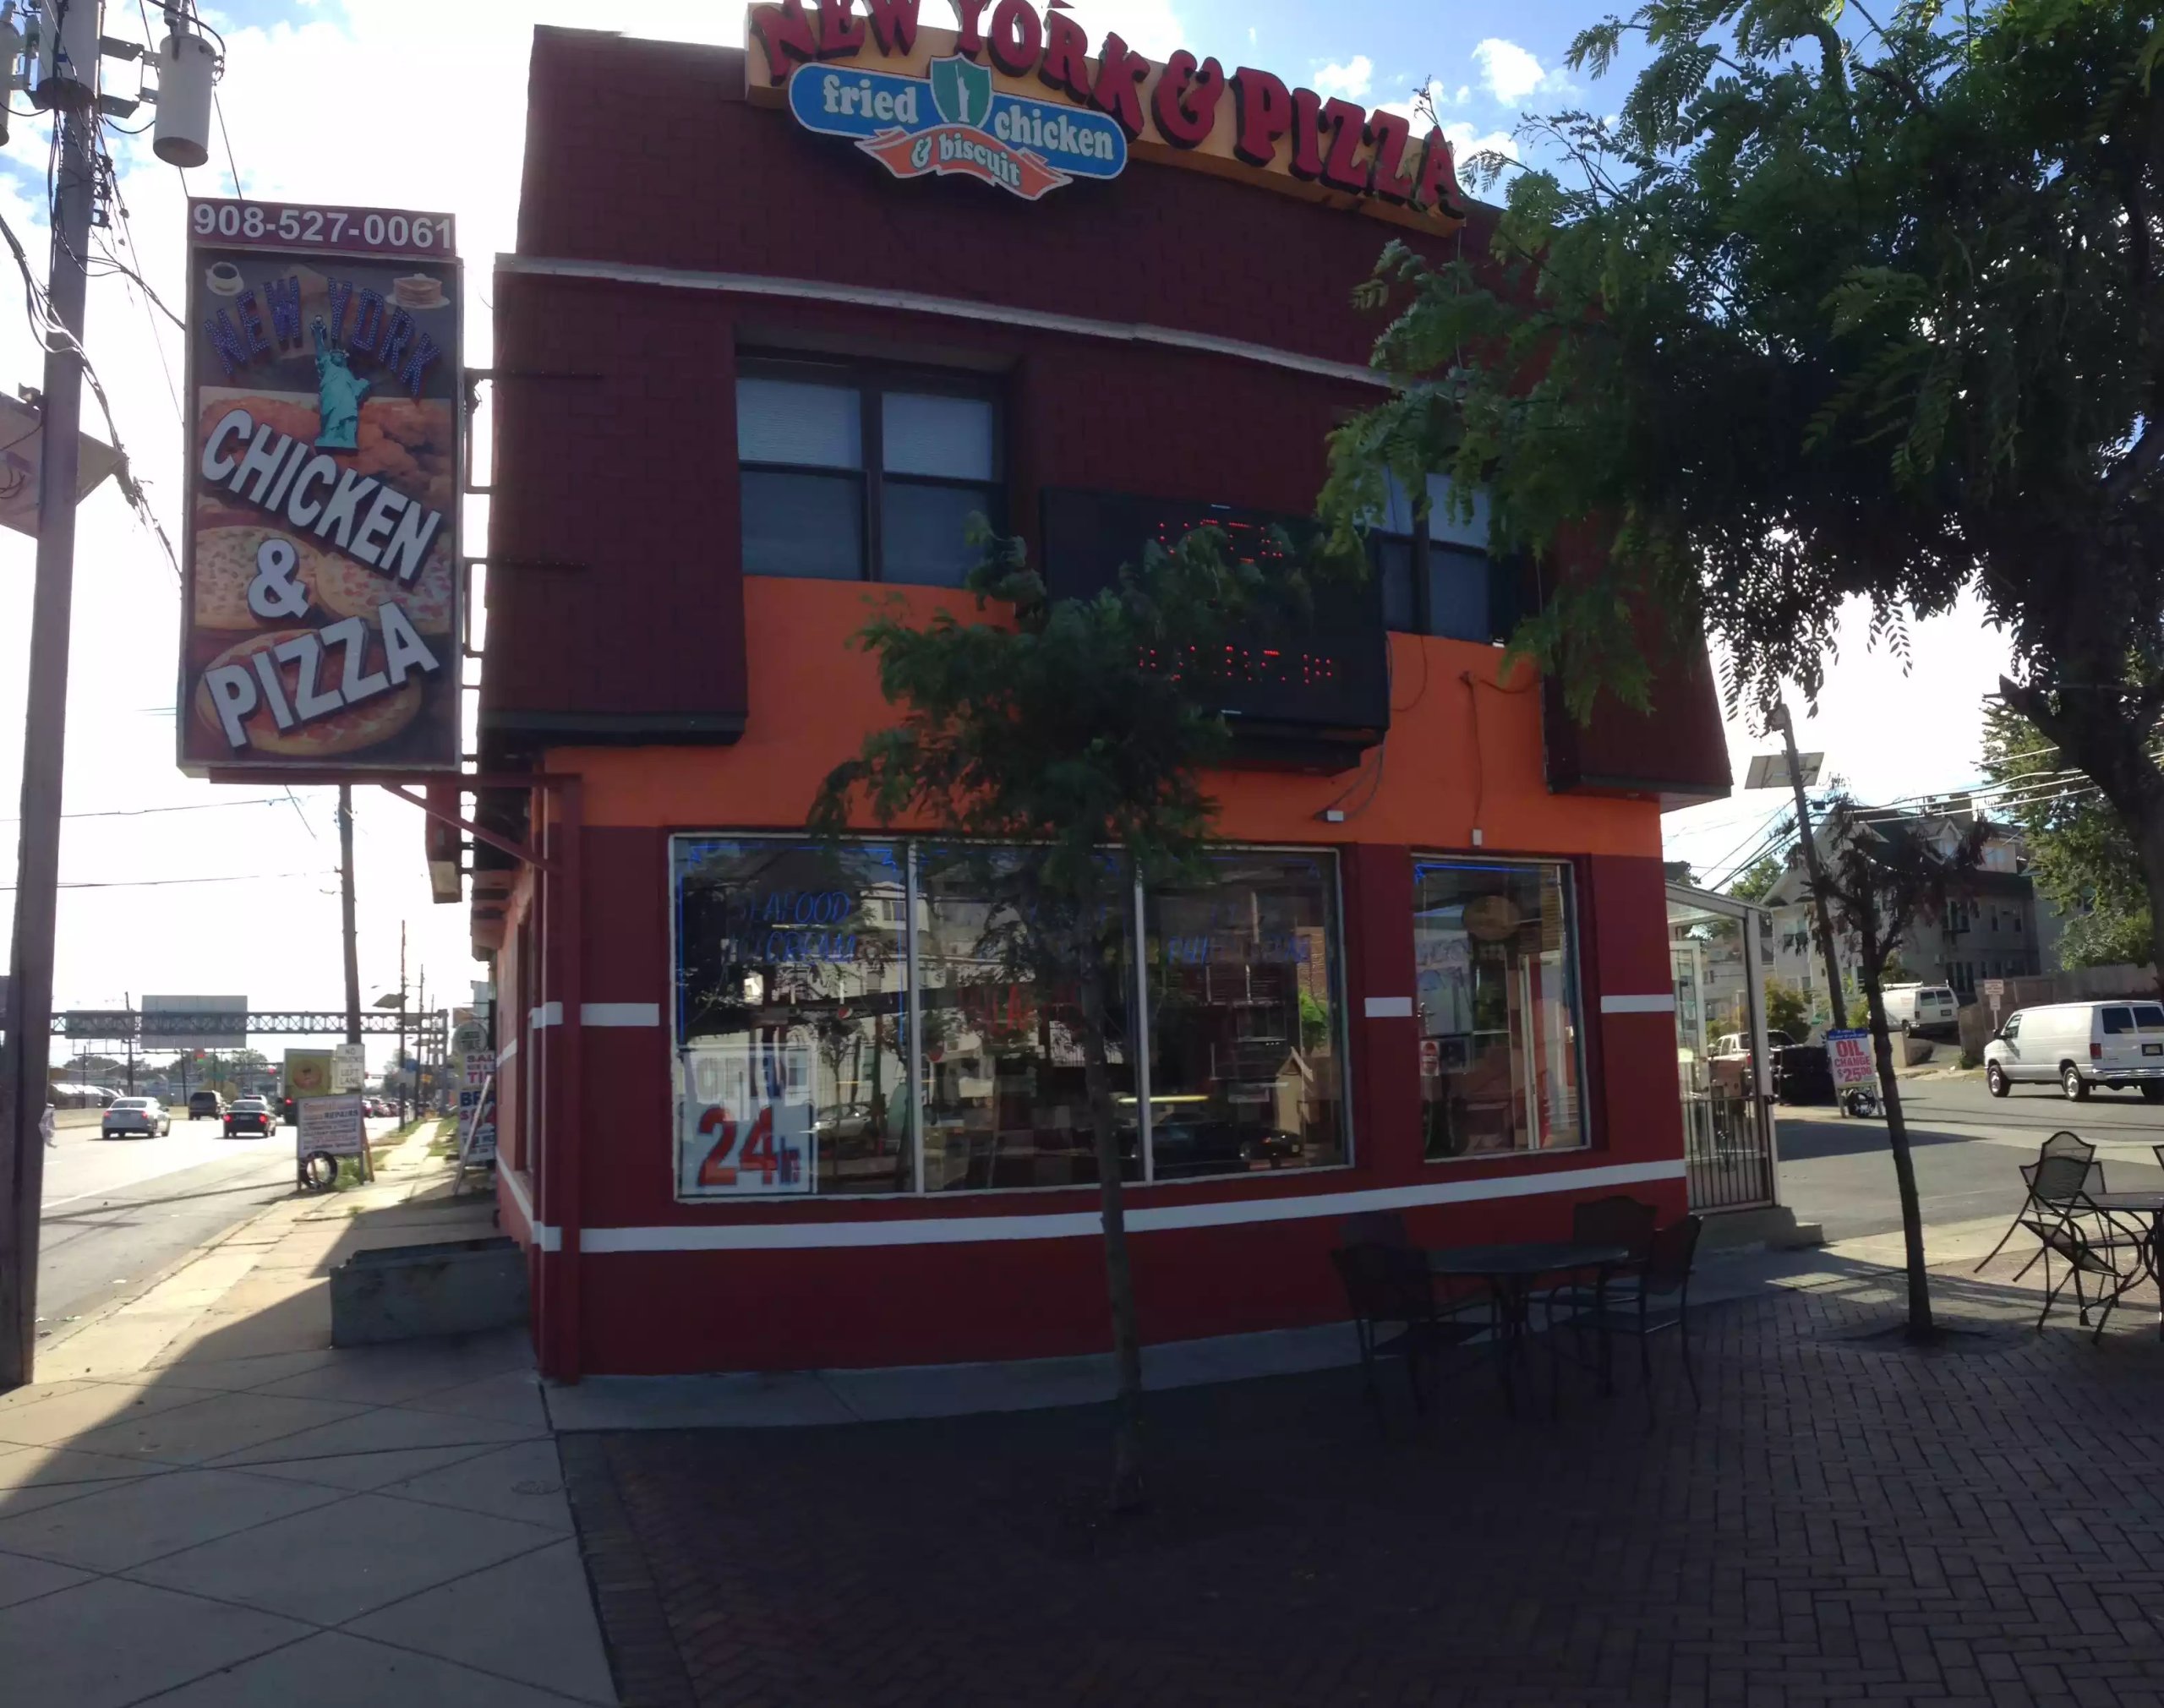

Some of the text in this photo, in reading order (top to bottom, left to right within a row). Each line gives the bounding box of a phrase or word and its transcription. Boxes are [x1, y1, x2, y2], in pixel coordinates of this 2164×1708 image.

[750, 0, 1467, 221] NEW YORK & PIZZA
[822, 74, 1114, 160] fried chicken
[910, 133, 1020, 187] & biscuit
[193, 203, 452, 248] 908-527-0061
[203, 275, 441, 397] NEW YORK
[200, 409, 442, 581] CHICKEN
[247, 538, 309, 619] &
[205, 601, 440, 749] PIZZA
[1834, 1056, 1871, 1067] CHANGE
[1836, 1040, 1864, 1057] OIL
